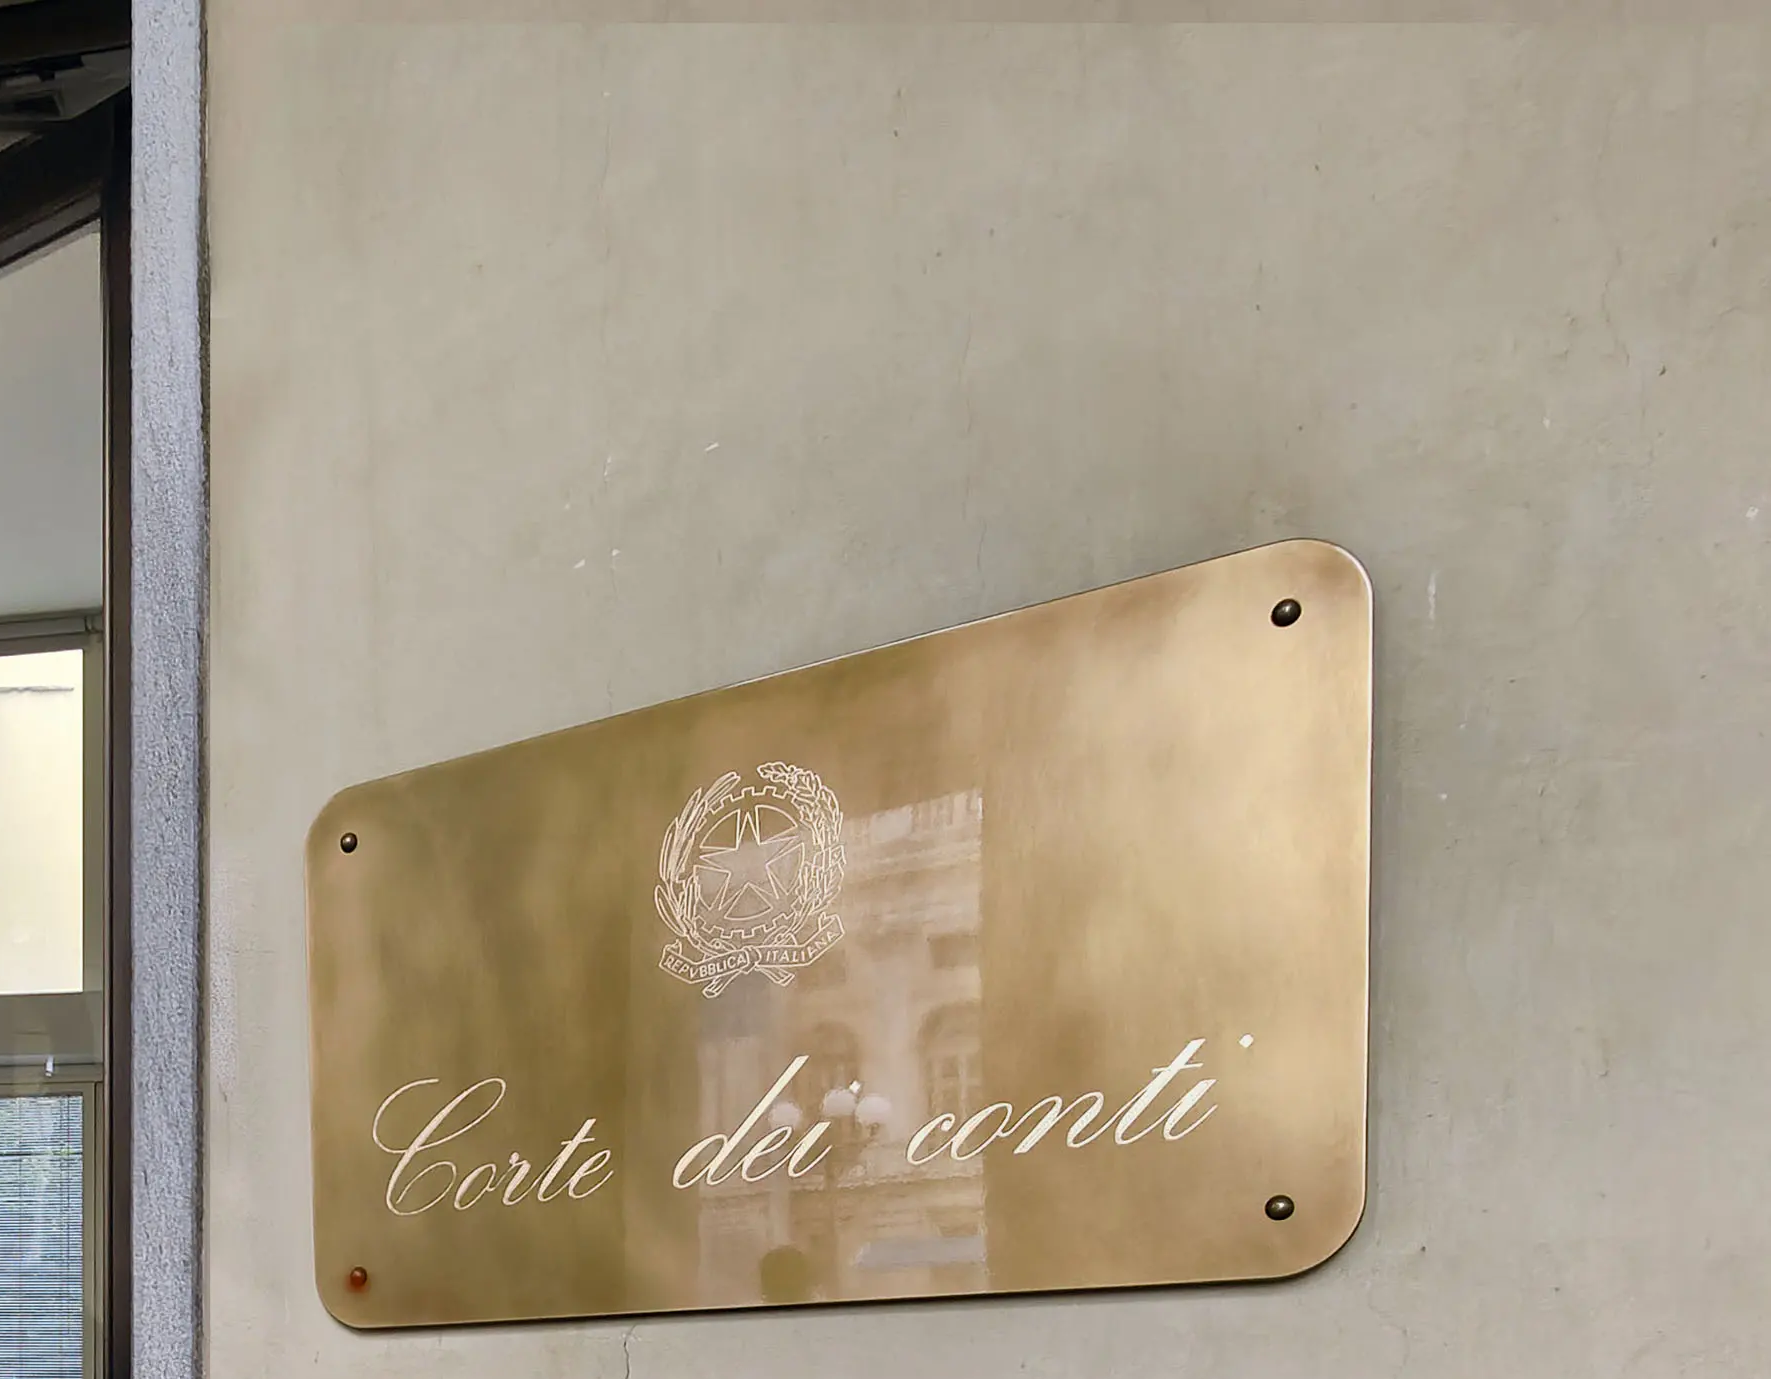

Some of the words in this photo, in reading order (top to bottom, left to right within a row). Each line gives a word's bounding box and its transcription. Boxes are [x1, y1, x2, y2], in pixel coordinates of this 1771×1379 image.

[766, 930, 839, 963] ITALIANA
[372, 1077, 615, 1217] Corte
[671, 1054, 862, 1190] dei
[906, 1034, 1254, 1165] conti
